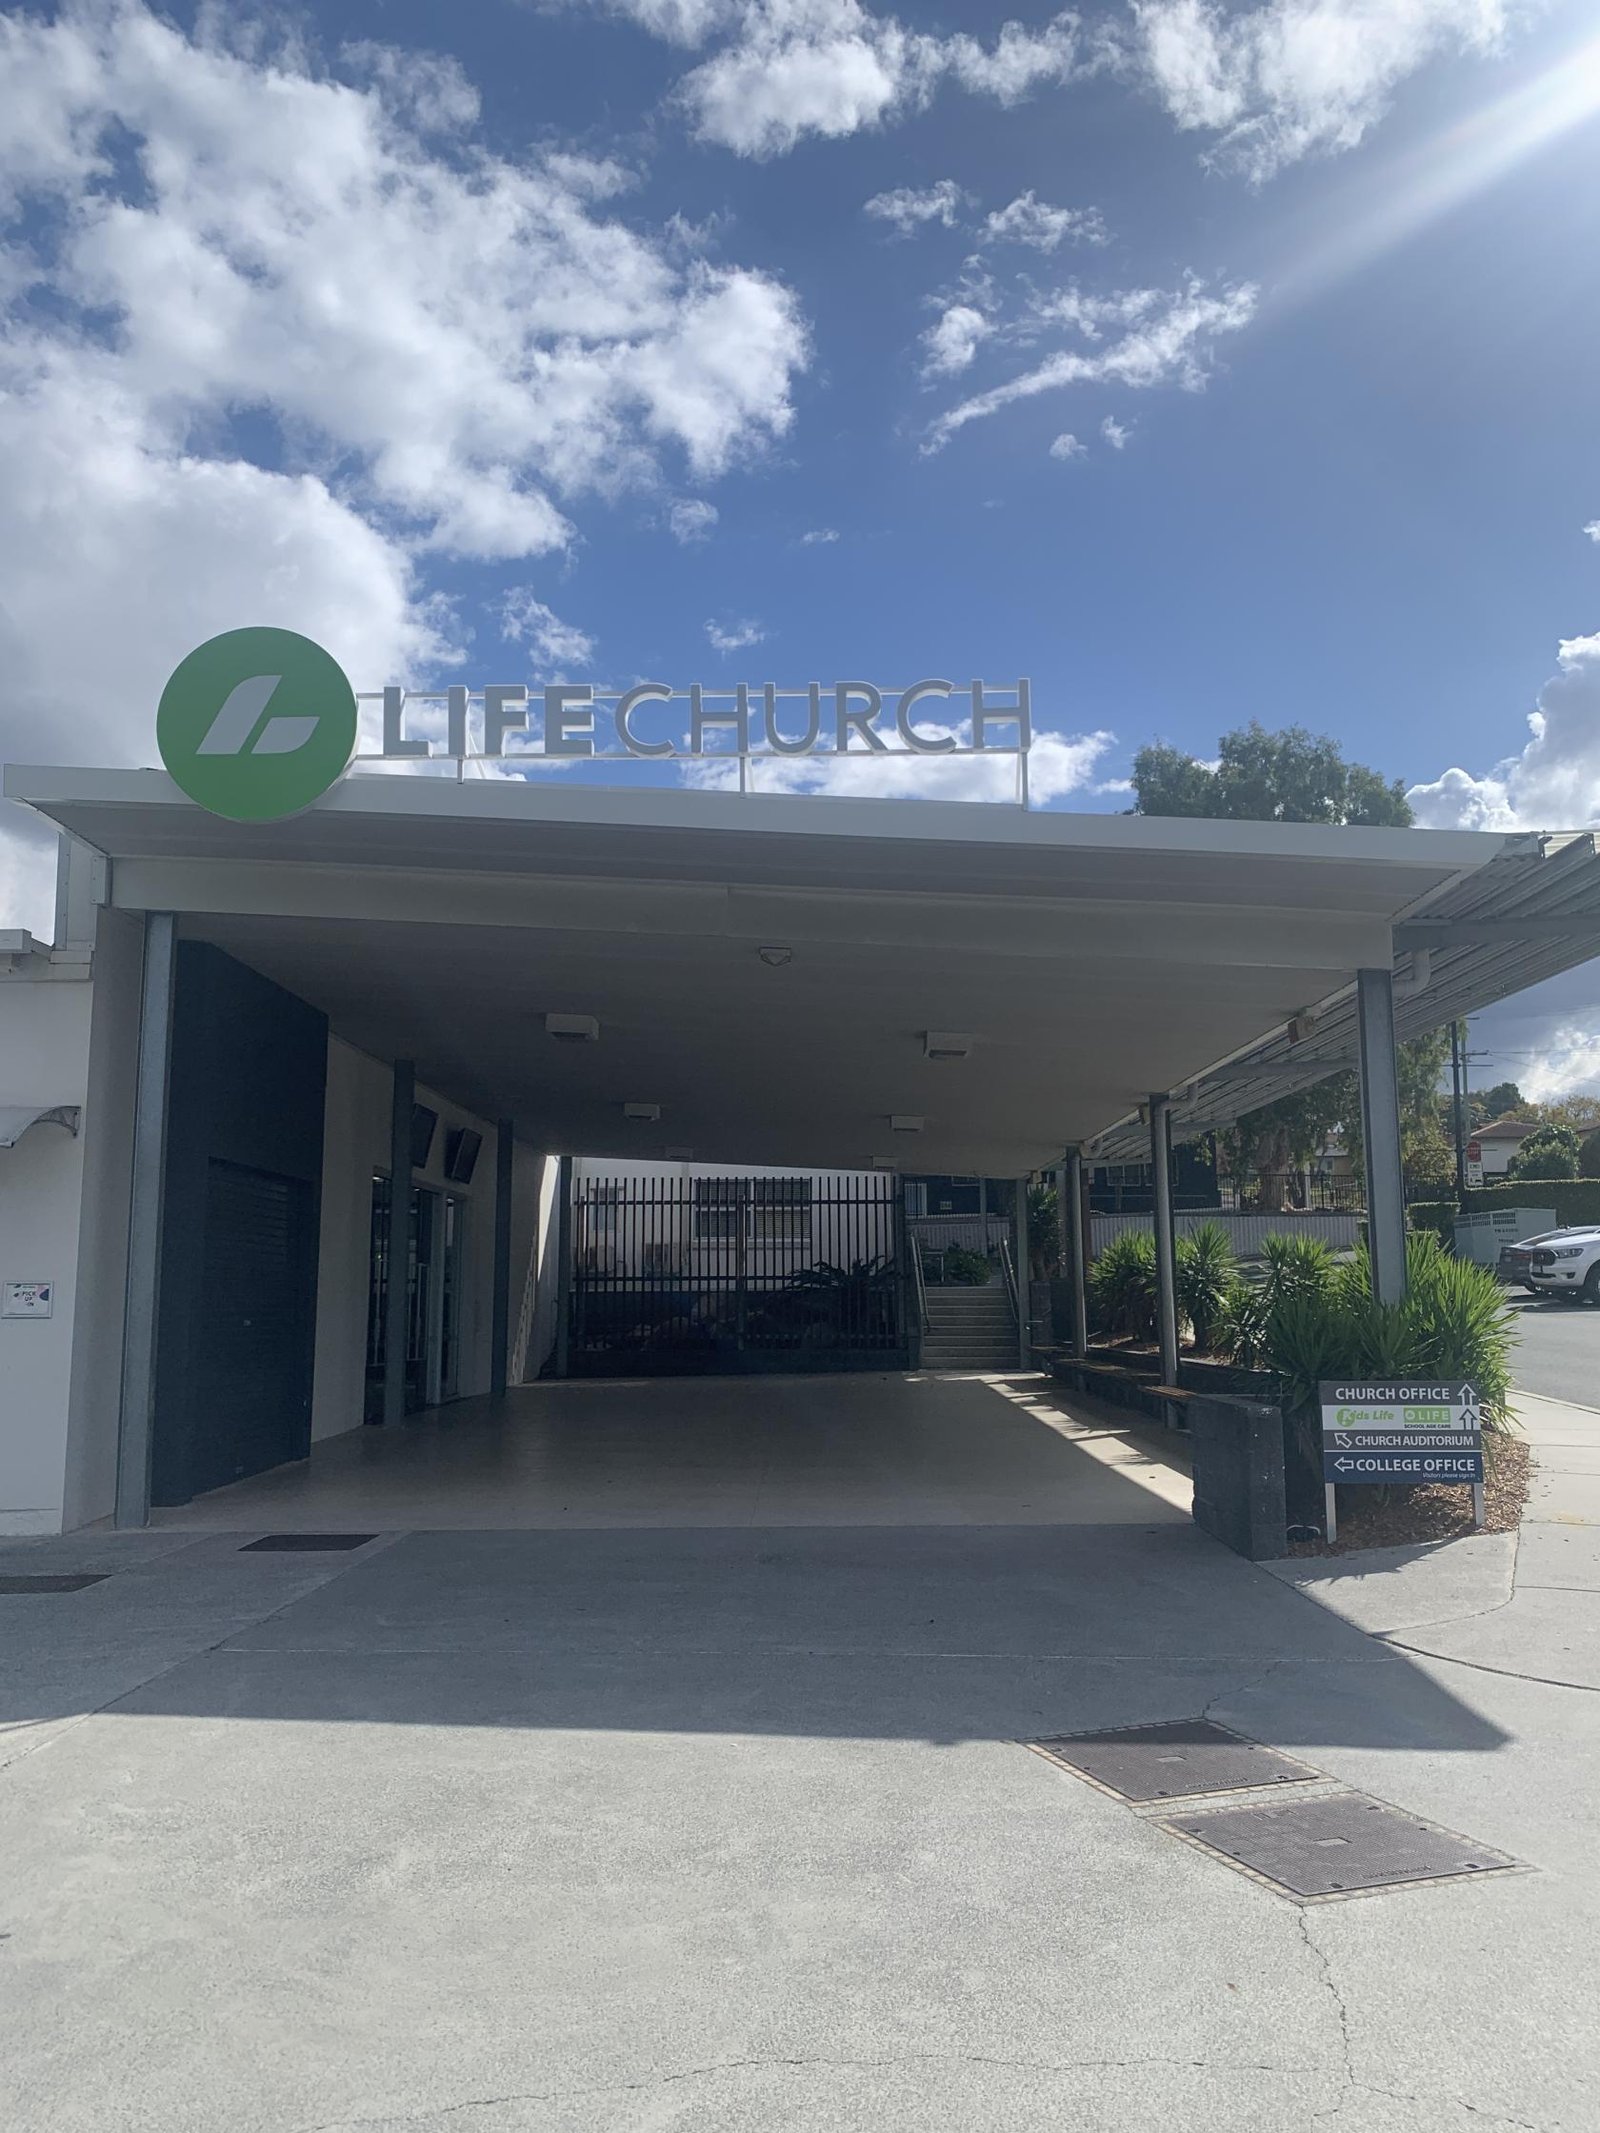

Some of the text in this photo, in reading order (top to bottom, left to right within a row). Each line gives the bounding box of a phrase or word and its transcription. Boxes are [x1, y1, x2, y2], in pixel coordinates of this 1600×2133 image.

[1335, 1387, 1450, 1400] CHURCH OFFICE
[1372, 1410, 1395, 1421] Life
[1418, 1409, 1449, 1421] LIFE
[1355, 1435, 1474, 1446] CHURCH AUDITORIUM
[1356, 1459, 1475, 1472] COLLEGE OFFICE
